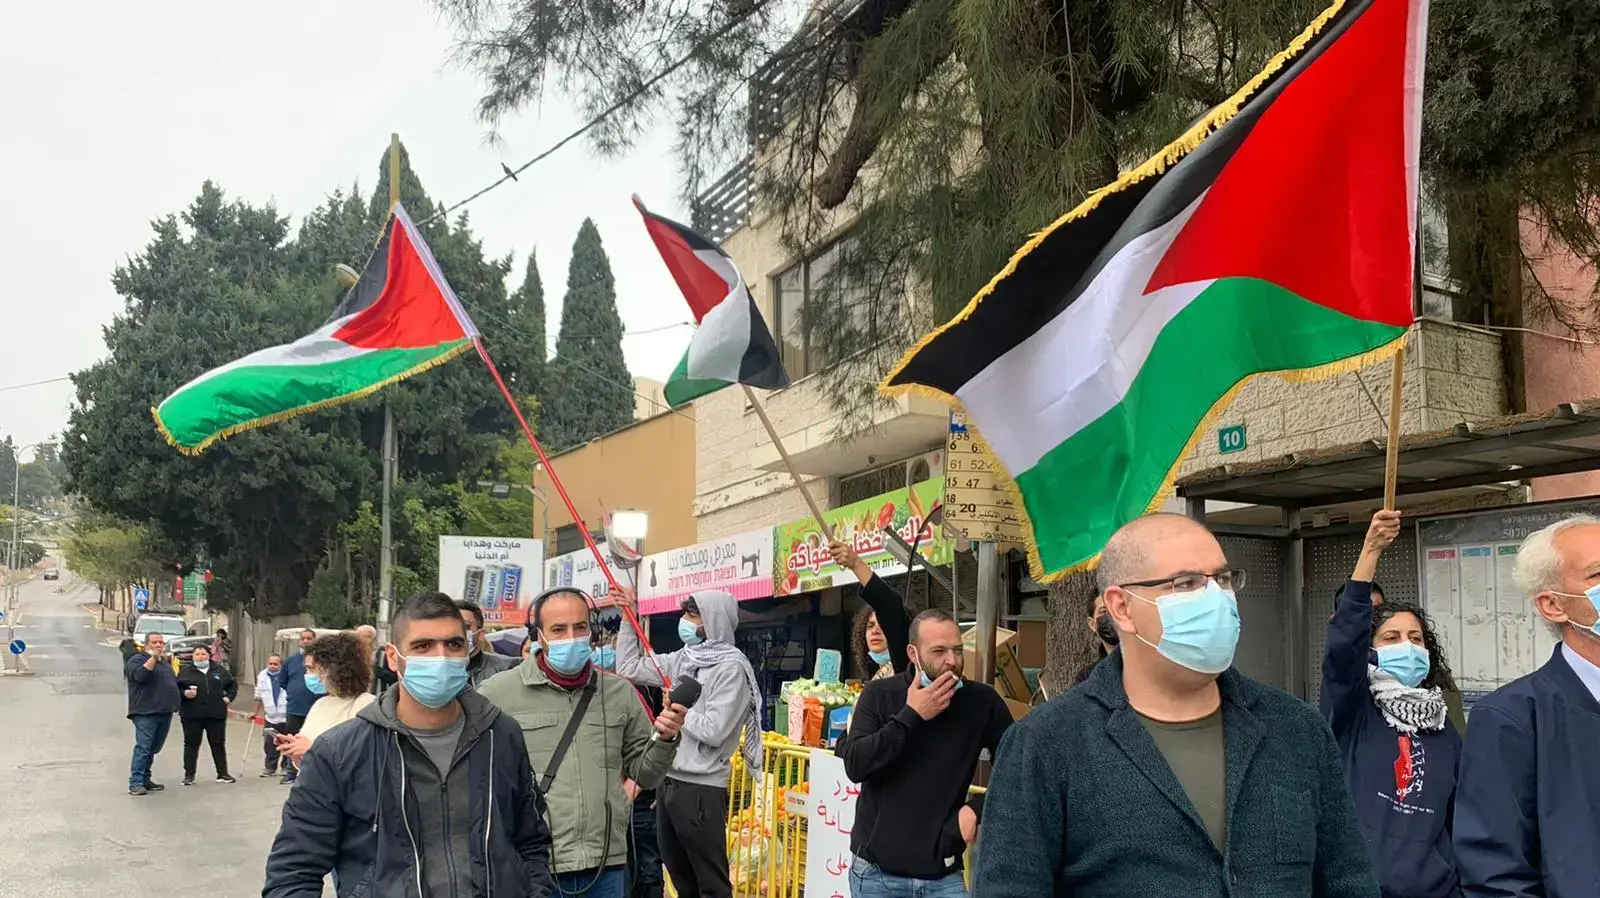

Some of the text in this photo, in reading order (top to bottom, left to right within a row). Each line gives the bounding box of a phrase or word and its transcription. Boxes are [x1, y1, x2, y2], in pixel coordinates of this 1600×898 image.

[949, 439, 957, 450] 6
[1223, 430, 1241, 448] 10
[950, 459, 961, 469] 61
[946, 477, 979, 488] 15 47
[946, 493, 956, 503] 18
[945, 509, 956, 518] 64
[959, 503, 976, 513] 20
[962, 527, 968, 537] 5
[463, 539, 521, 551] ماركت وهدايا
[474, 550, 509, 562] أم الدنيا
[503, 574, 518, 602] BLU
[825, 852, 848, 876] على
